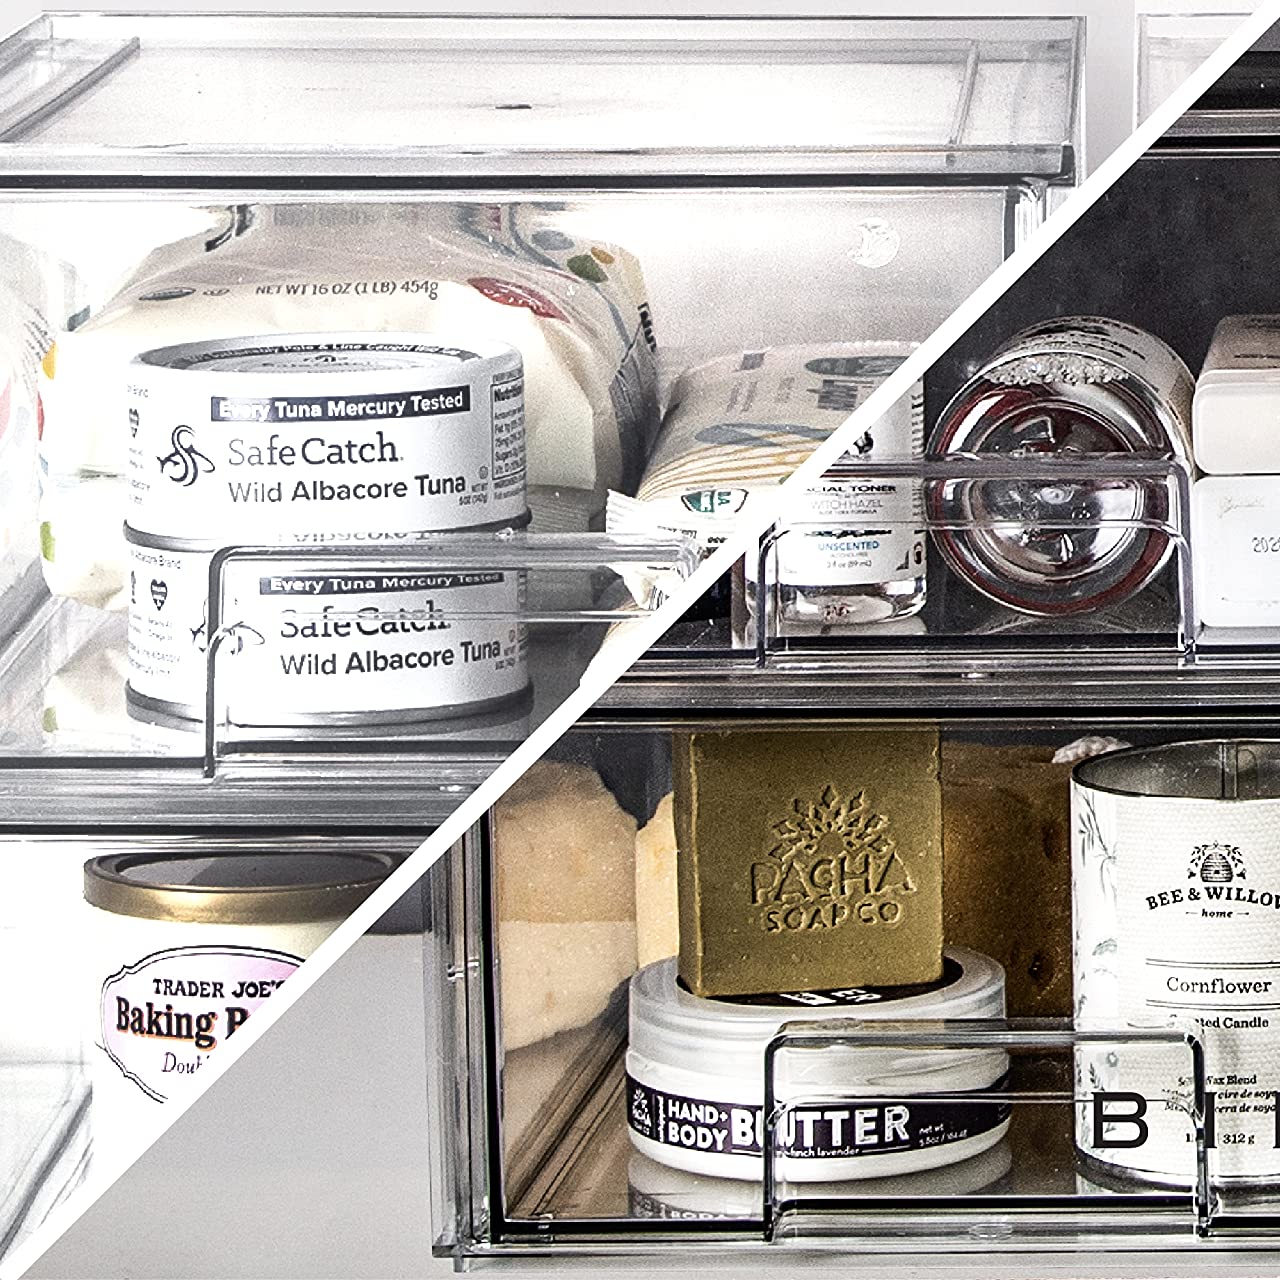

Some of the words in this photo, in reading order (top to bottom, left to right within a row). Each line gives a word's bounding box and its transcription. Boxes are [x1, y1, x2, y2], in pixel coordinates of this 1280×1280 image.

[255, 284, 282, 296] NET
[285, 283, 310, 296] WT
[311, 283, 329, 295] 16
[332, 282, 351, 295] OZ
[354, 281, 368, 296] (1
[372, 280, 397, 296] LB)
[400, 279, 439, 301] 454g
[218, 399, 271, 423] Every
[275, 400, 322, 419] Tuna
[327, 398, 407, 418] Mercury
[409, 391, 464, 412] Tested
[228, 480, 282, 504] Wild
[291, 480, 408, 502] Albacore
[414, 474, 467, 497] Tuna
[851, 484, 897, 493] TONER
[849, 499, 884, 509] HAZEL
[817, 540, 881, 552] UNSCENTED
[270, 577, 324, 594] Every
[329, 578, 376, 590] Tuna
[382, 575, 454, 589] Mercury
[457, 572, 500, 584] Tested
[279, 652, 337, 676] Wild
[344, 649, 454, 675] Albacore
[459, 640, 501, 664] Tuna
[751, 851, 917, 904] PACHA
[1145, 888, 1185, 911] BEE
[1187, 887, 1201, 901] &
[767, 902, 849, 932] SOAP
[858, 901, 902, 925] CO
[1200, 908, 1234, 919] home
[152, 978, 226, 999] TRADER
[1166, 976, 1273, 994] Cornflower
[115, 995, 218, 1052] Baking
[1222, 1016, 1270, 1029] Candle
[1226, 1073, 1257, 1086] Blend
[1240, 1088, 1253, 1099] de
[667, 1098, 729, 1124] HAND+
[1239, 1103, 1251, 1113] de
[667, 1120, 729, 1152] BODY
[1222, 1132, 1246, 1145] 312
[816, 1146, 860, 1158] lavender
